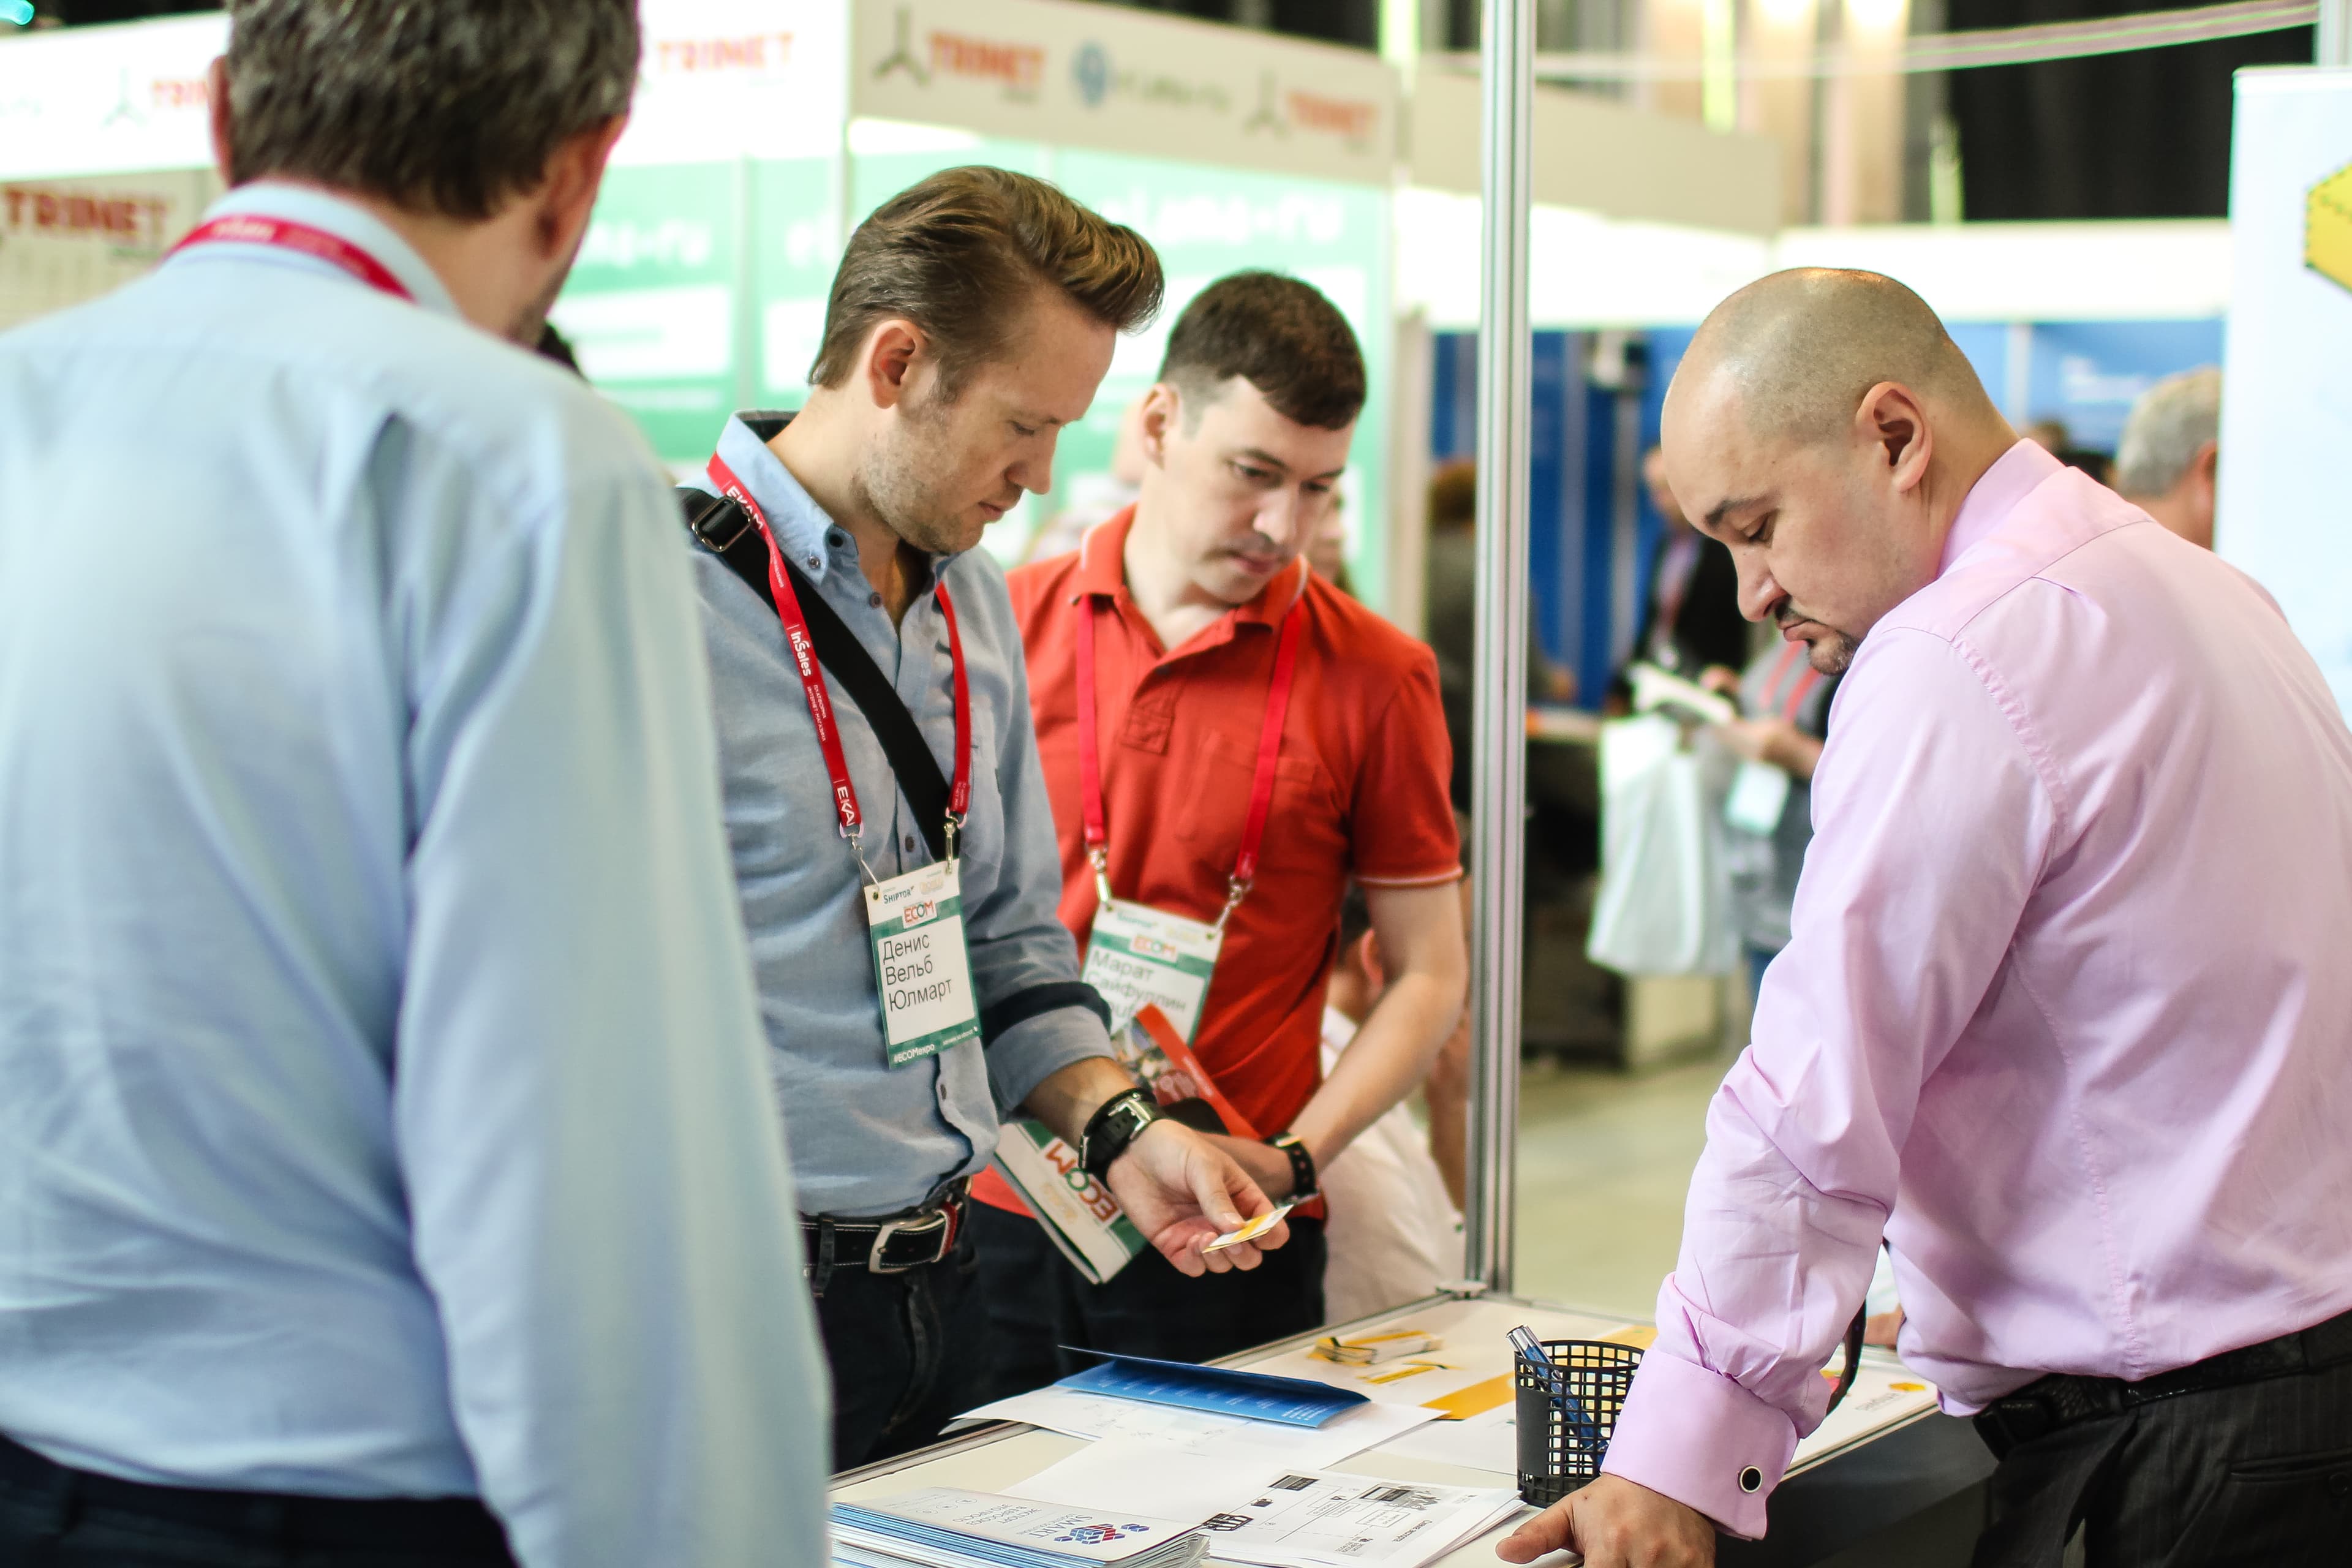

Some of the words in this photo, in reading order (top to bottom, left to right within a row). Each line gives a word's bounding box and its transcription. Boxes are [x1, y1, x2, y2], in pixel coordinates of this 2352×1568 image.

[790, 631, 812, 677] InSales
[813, 684, 827, 719] ПЛАТФОРМА
[836, 785, 856, 827] EKA
[903, 899, 935, 924] ECOM
[883, 934, 930, 965] Денис
[885, 954, 933, 986] Вельб
[1091, 950, 1155, 982] Марат
[888, 979, 952, 1012] Юлмарт
[894, 1043, 935, 1063] #ECOMexpo
[1045, 1141, 1118, 1223] ECOM
[1024, 1514, 1093, 1539] SMART
